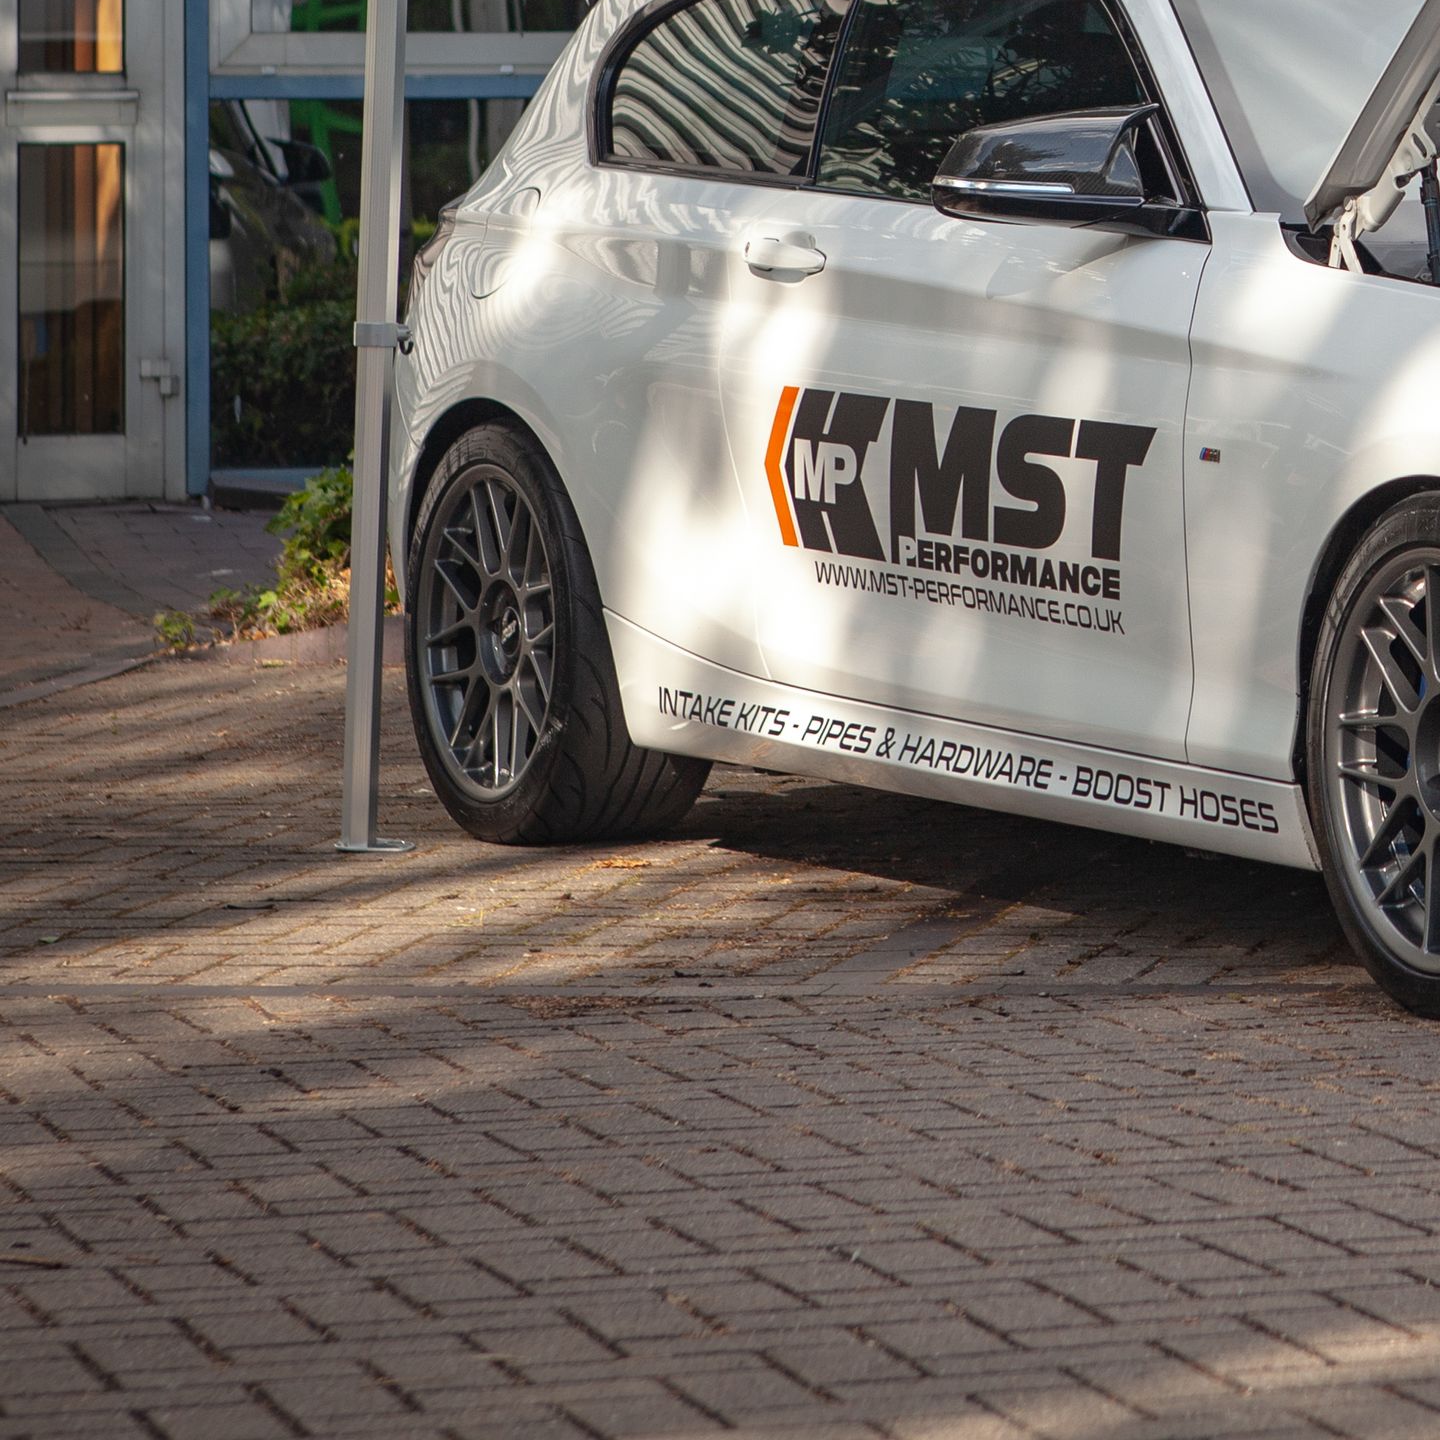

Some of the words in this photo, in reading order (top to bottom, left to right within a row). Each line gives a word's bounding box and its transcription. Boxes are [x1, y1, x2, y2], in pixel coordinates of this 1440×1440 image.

[890, 398, 1158, 563] MST
[814, 561, 1126, 635] WWW.MST-PERFORMANCE.CO.UK
[898, 535, 1120, 600] PERFORMANCE
[658, 686, 736, 728] INTAKE
[733, 703, 786, 736] KITS
[800, 713, 877, 756] PIPES
[876, 734, 896, 759] &
[899, 733, 1054, 790] HARDWARE
[1072, 766, 1171, 812] BOOST
[1179, 787, 1280, 833] HOSES
